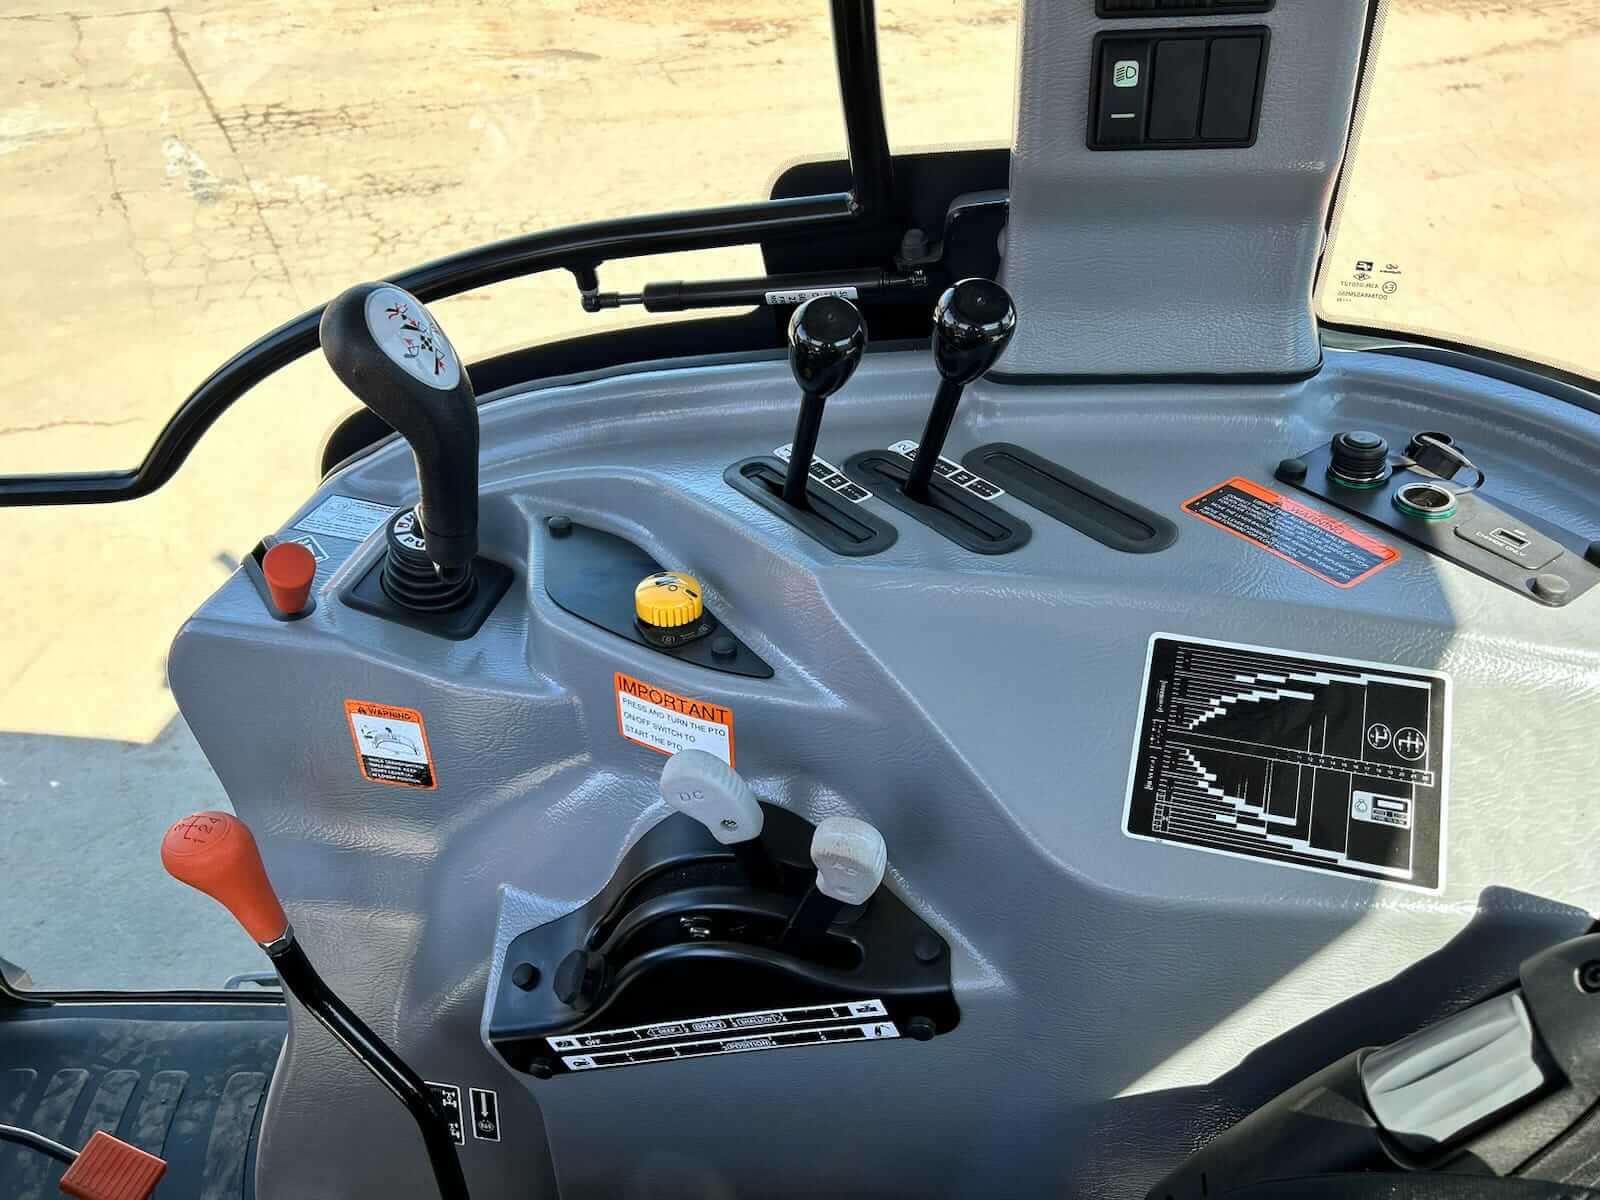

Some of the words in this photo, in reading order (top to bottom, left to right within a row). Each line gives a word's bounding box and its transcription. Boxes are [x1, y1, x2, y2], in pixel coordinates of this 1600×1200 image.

[619, 676, 728, 723] IMPORTANT
[623, 698, 647, 713] PRESS
[649, 708, 665, 719] AND
[667, 714, 688, 727] TURN
[691, 722, 706, 733] THE
[708, 726, 726, 737] PTO
[625, 725, 648, 739] START
[651, 734, 665, 746] THE
[667, 741, 683, 752] PTO
[652, 723, 683, 738] SWITCH
[685, 733, 696, 743] TO
[727, 1039, 769, 1051] POSITION
